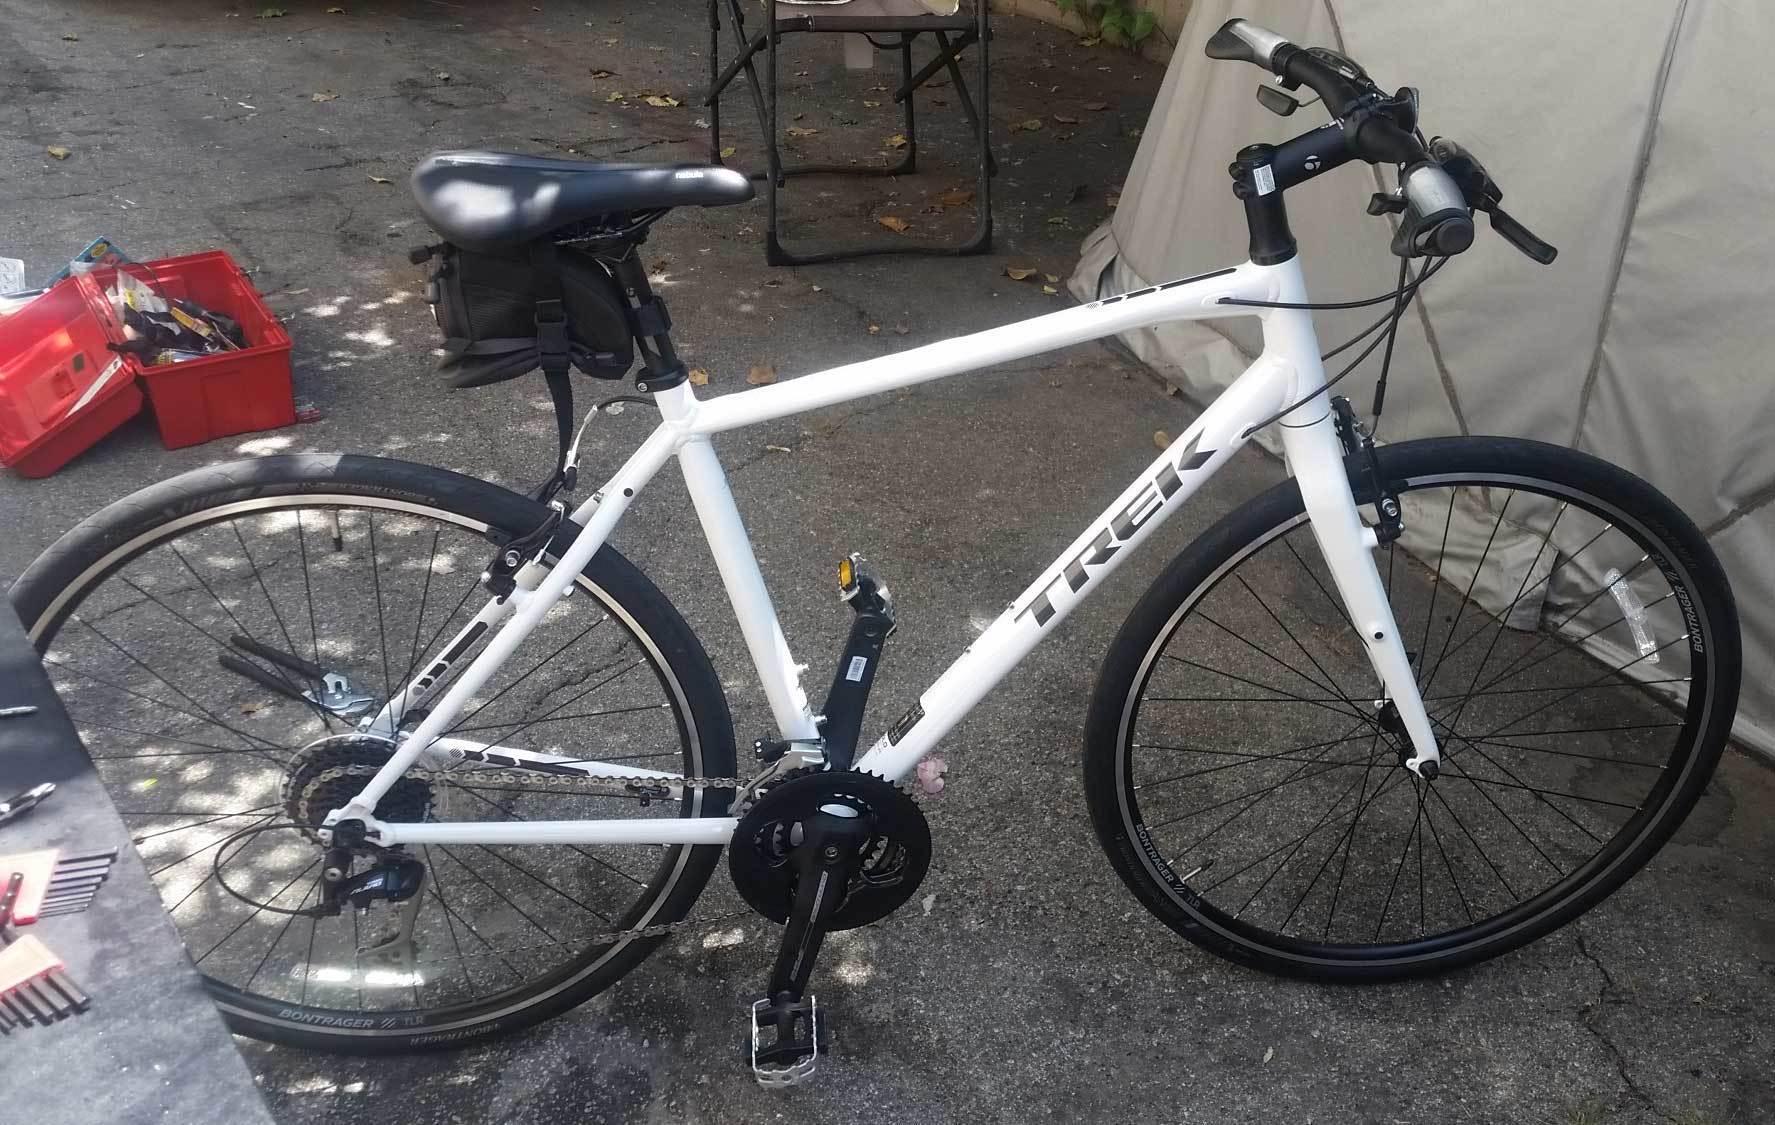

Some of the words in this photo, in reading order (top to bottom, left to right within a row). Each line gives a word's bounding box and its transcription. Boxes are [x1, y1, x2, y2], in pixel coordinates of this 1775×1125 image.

[1014, 427, 1218, 627] TREK
[1675, 585, 1703, 653] BONTRAGER
[1136, 823, 1174, 882] BONTRAGER
[278, 1008, 374, 1029] BONTRAGER
[402, 1015, 424, 1026] TLR
